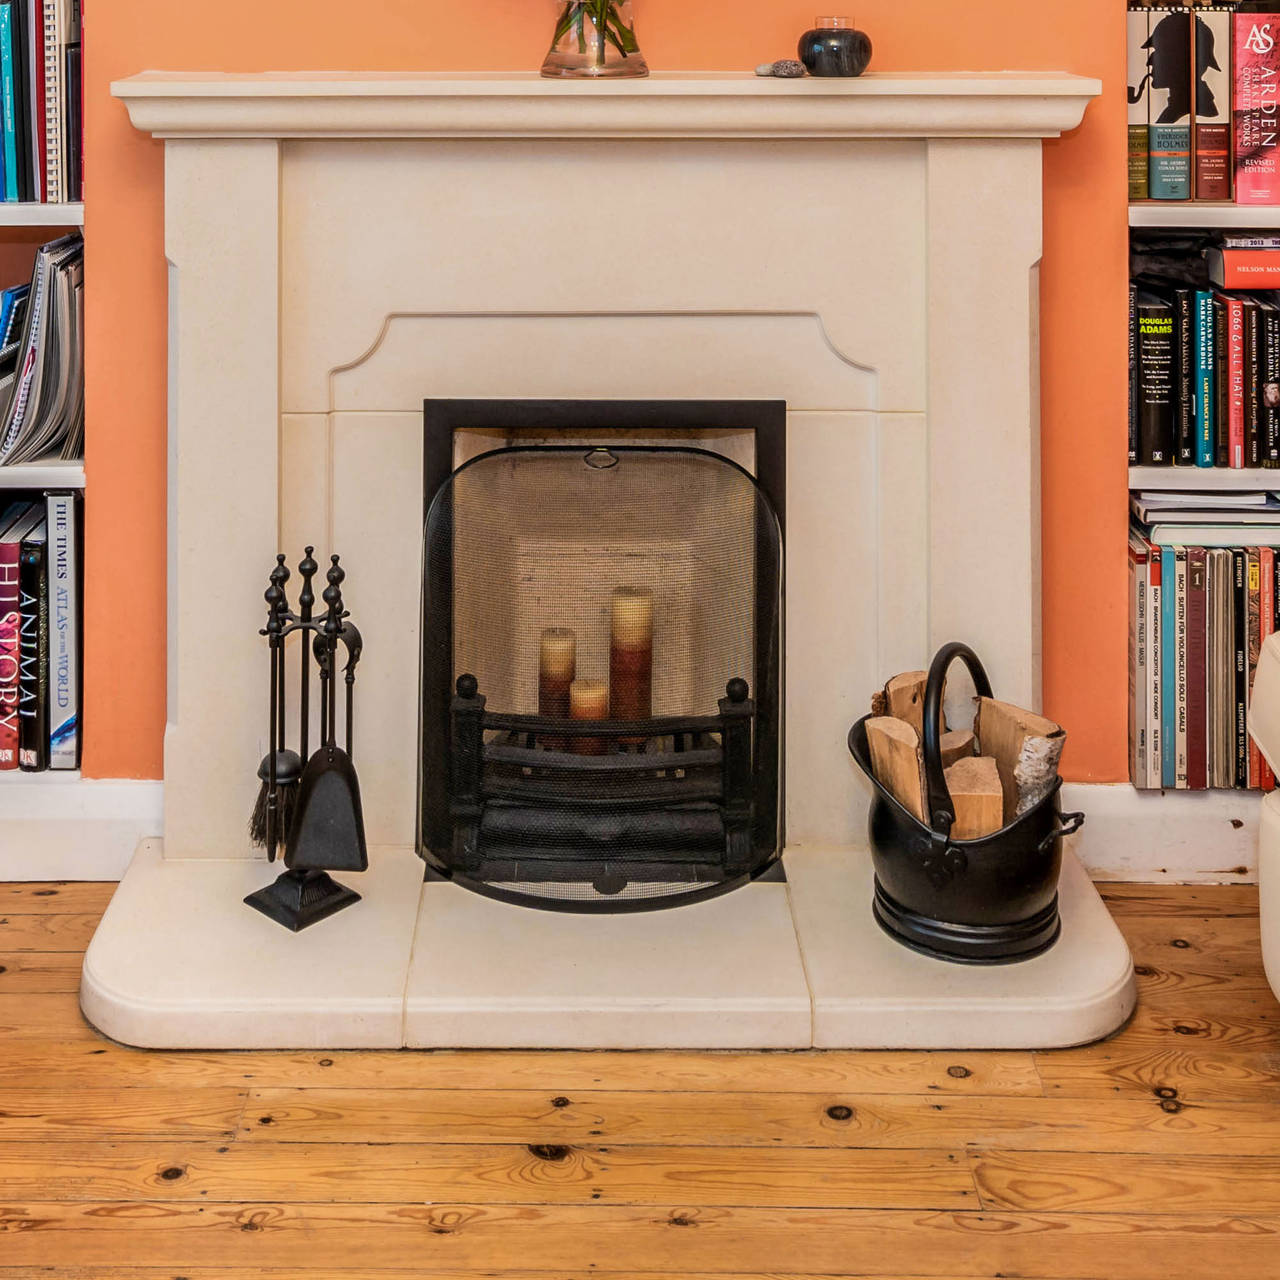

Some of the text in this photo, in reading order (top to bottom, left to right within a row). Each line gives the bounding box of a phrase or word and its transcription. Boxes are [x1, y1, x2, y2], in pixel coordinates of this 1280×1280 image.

[1242, 68, 1251, 146] COMPLETE WORKS
[1252, 68, 1260, 146] SHAKESPEARE
[1261, 66, 1276, 146] ARDEN
[1232, 304, 1242, 330] 1066
[1233, 345, 1242, 365] ALL
[1233, 370, 1242, 398] THAT
[56, 501, 67, 530] THE
[57, 534, 67, 579] TIMES
[58, 586, 68, 631] ATLAS
[58, 654, 68, 708] WORLD
